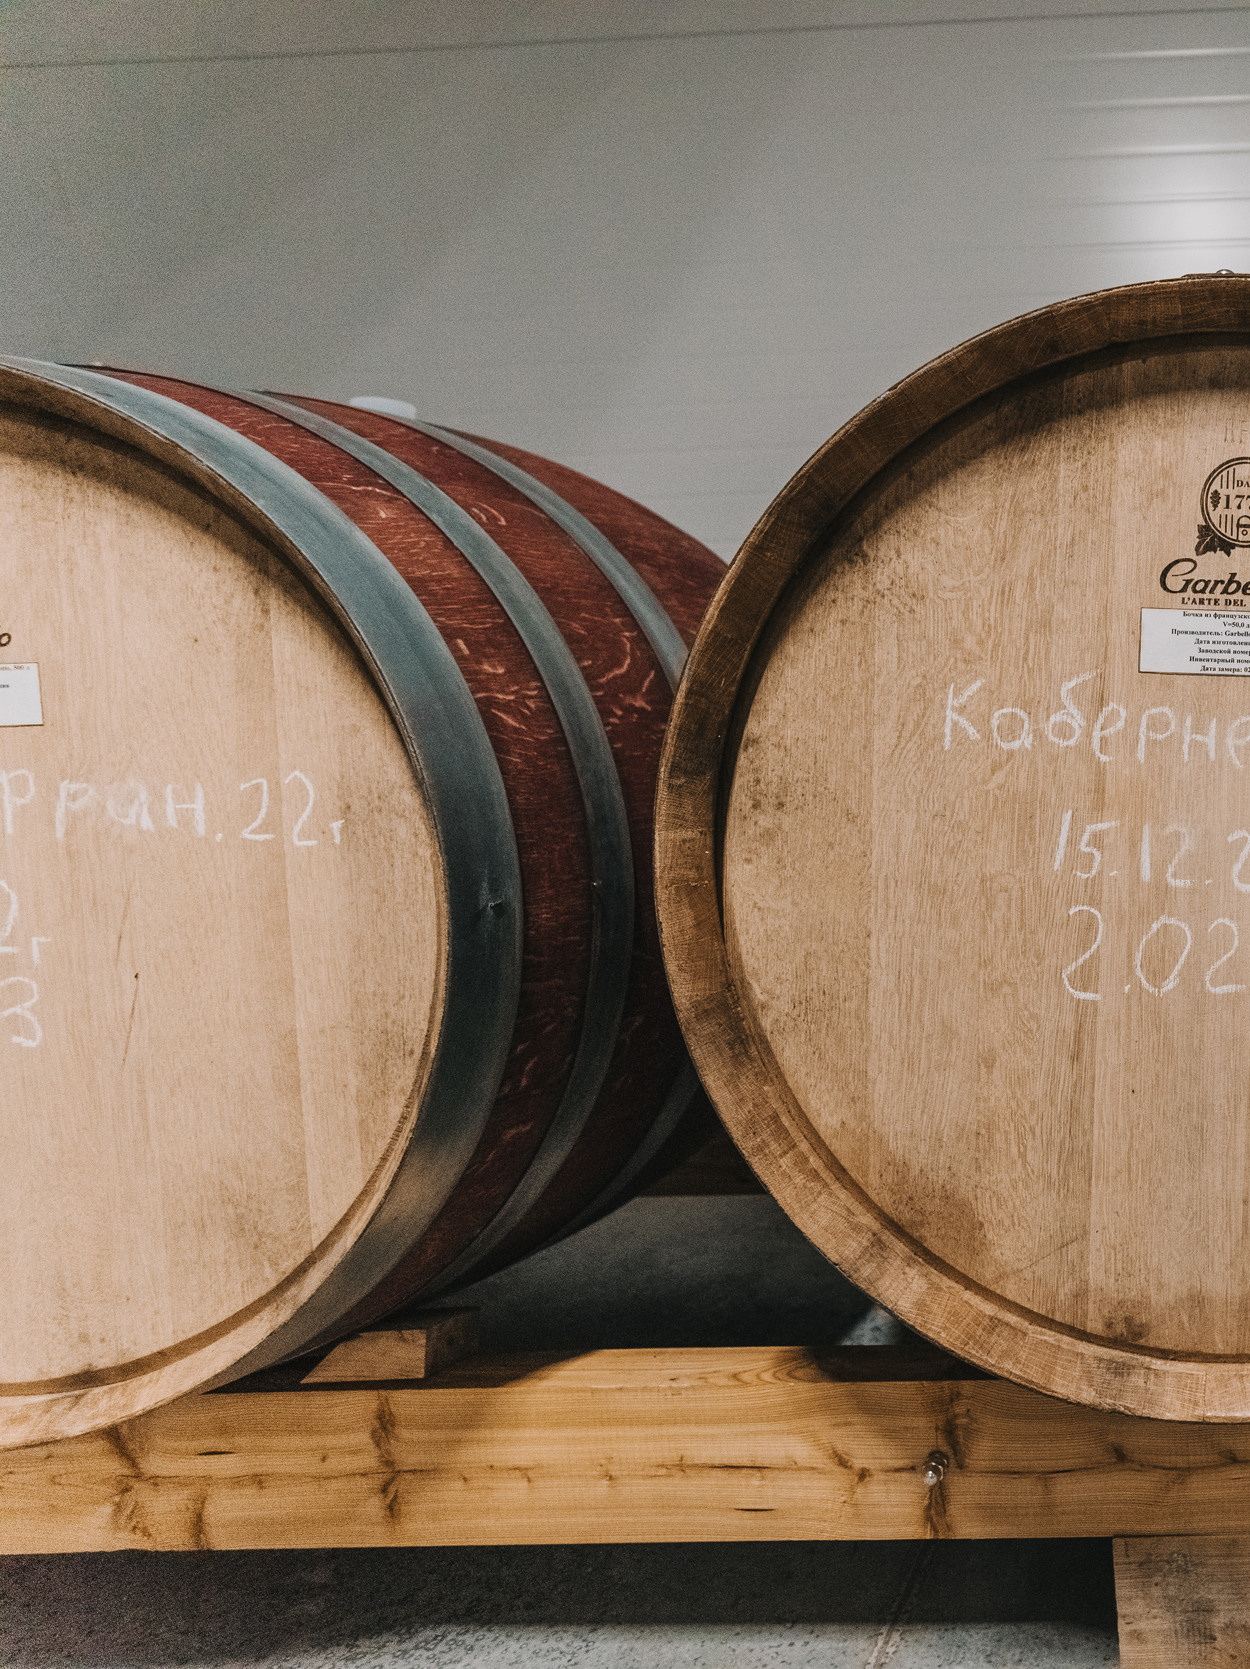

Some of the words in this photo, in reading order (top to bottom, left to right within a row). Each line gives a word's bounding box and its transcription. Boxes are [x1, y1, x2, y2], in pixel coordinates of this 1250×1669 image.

[1224, 598, 1247, 607] DEL
[1171, 628, 1223, 637] Производитель:
[1197, 647, 1231, 655] Заводской
[1189, 656, 1235, 665] Инвентарный
[1199, 665, 1217, 673] Дата
